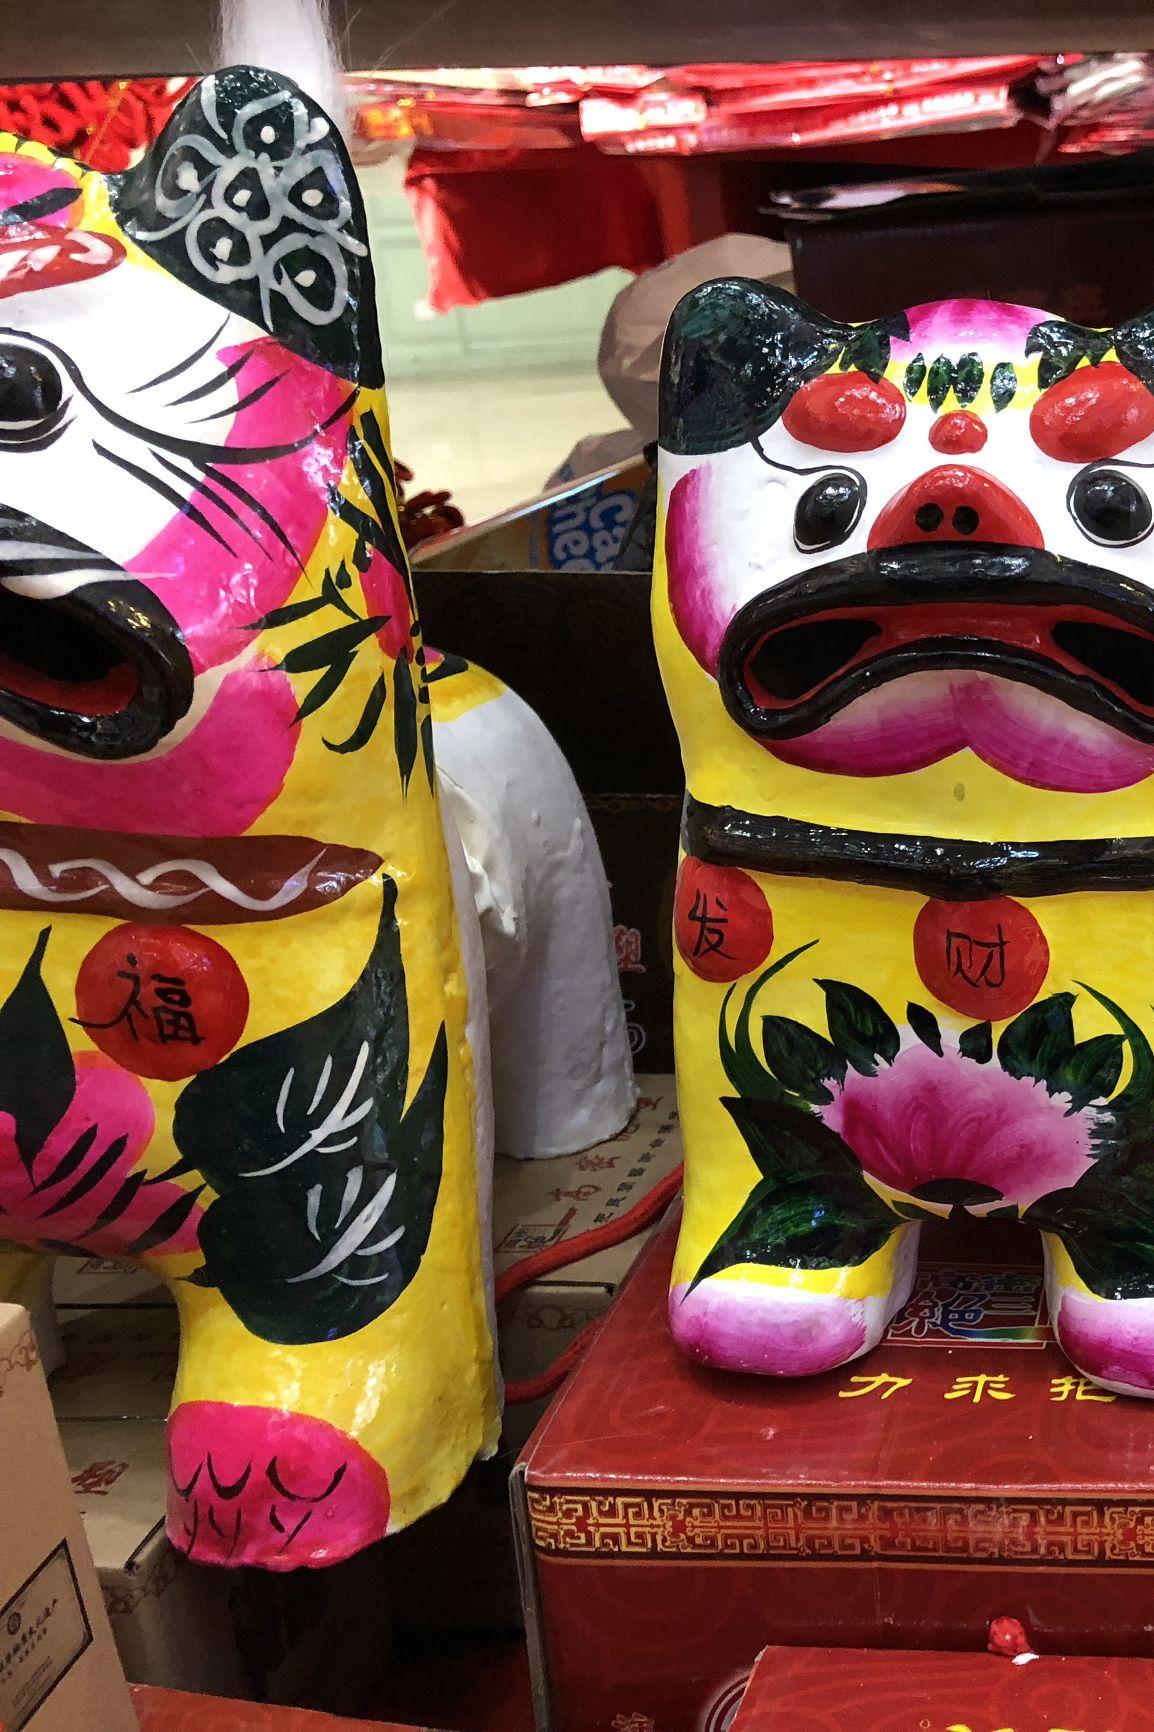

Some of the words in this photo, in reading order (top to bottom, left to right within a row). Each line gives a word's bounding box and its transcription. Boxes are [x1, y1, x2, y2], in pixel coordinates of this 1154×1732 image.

[687, 889, 739, 960] 发
[945, 923, 1008, 988] 财
[67, 953, 206, 1045] 福
